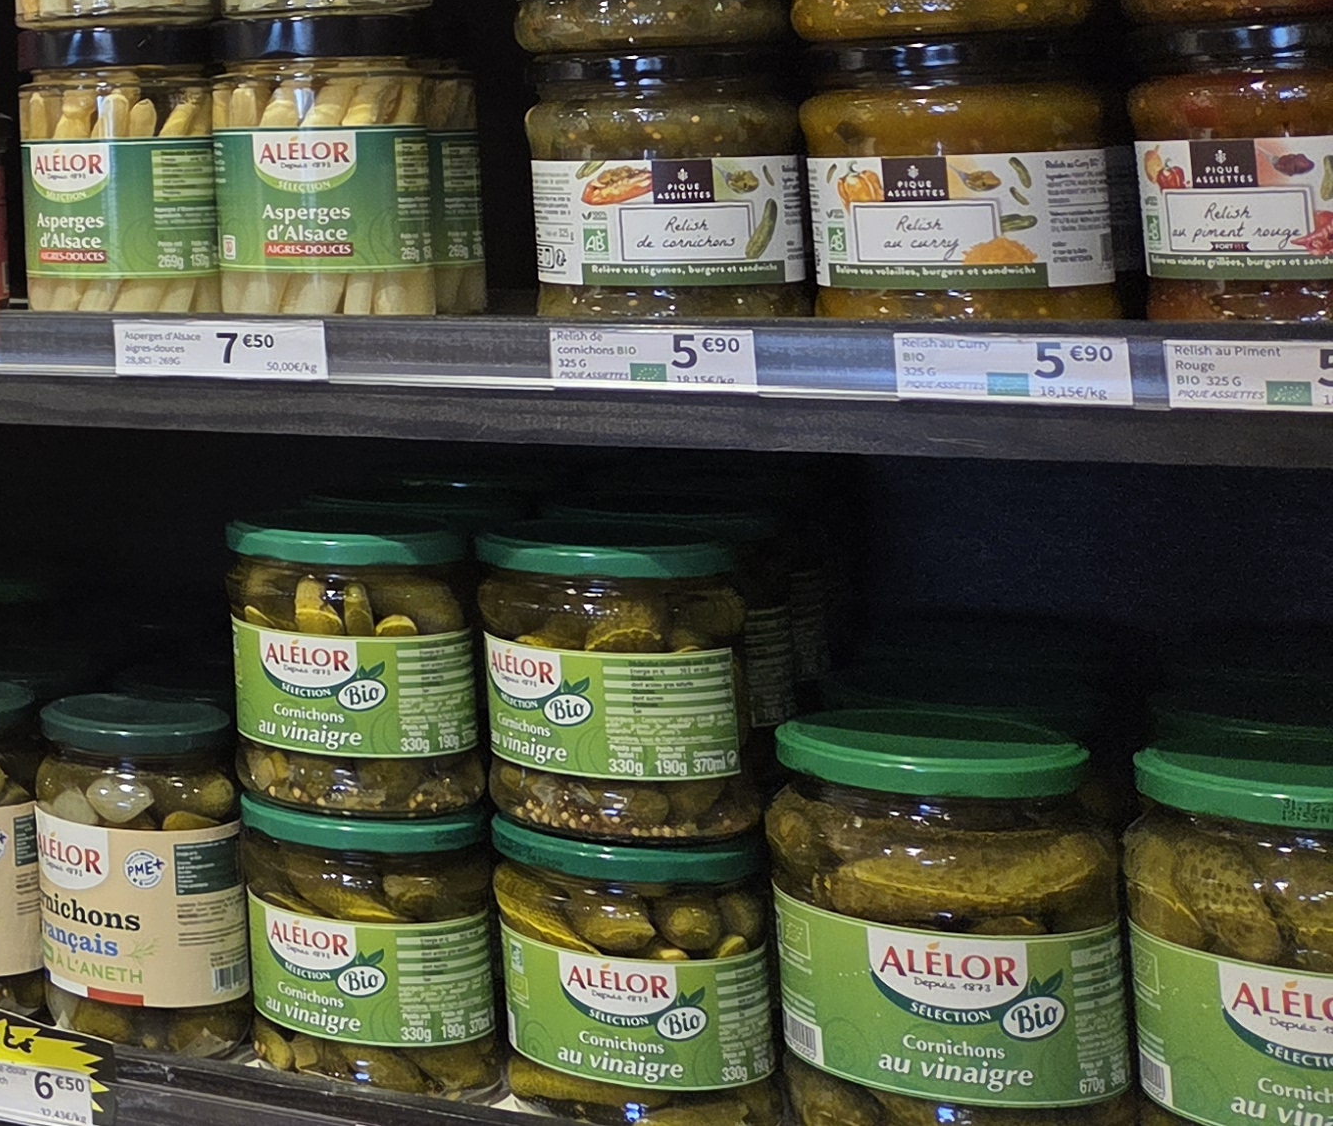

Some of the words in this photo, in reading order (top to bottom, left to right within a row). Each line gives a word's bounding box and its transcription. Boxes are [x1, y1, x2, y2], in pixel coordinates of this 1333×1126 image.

[259, 136, 350, 165] ALÉLOR
[1196, 174, 1254, 184] ASSIETTES
[1205, 166, 1240, 175] PIQUE
[887, 187, 947, 199] ASSIETTES
[262, 203, 351, 224] Asperges
[665, 216, 710, 233] Relish
[216, 332, 238, 364] 7
[243, 334, 274, 349] €50
[557, 345, 614, 355] cornichons
[617, 346, 637, 355] BIO
[671, 334, 698, 369] 5
[702, 337, 740, 353] €90
[903, 353, 925, 362] BIO
[1034, 341, 1065, 379] 5
[1070, 345, 1113, 362] €90
[266, 361, 318, 374] 50,00€/kg
[1175, 360, 1216, 373] Rouge
[265, 639, 351, 672] ALÉLOR
[491, 646, 555, 686] ALÉLOR
[273, 702, 345, 724] Cornichons
[549, 692, 588, 720] Bio
[258, 720, 278, 735] au
[281, 719, 363, 748] vinaigre
[608, 756, 645, 777] 330g
[655, 756, 688, 777] 190g
[270, 920, 350, 958] ALÉLOR
[879, 941, 1019, 987] ALÉLOR
[566, 962, 671, 999] ALÉLOR
[276, 980, 345, 1009] Cornichons
[663, 1008, 702, 1037] Bio
[578, 1029, 666, 1056] Cornichons
[901, 1033, 1006, 1060] Cornichons
[34, 1071, 54, 1099] 6
[55, 1076, 84, 1093] €50
[1078, 1076, 1106, 1095] 670g
